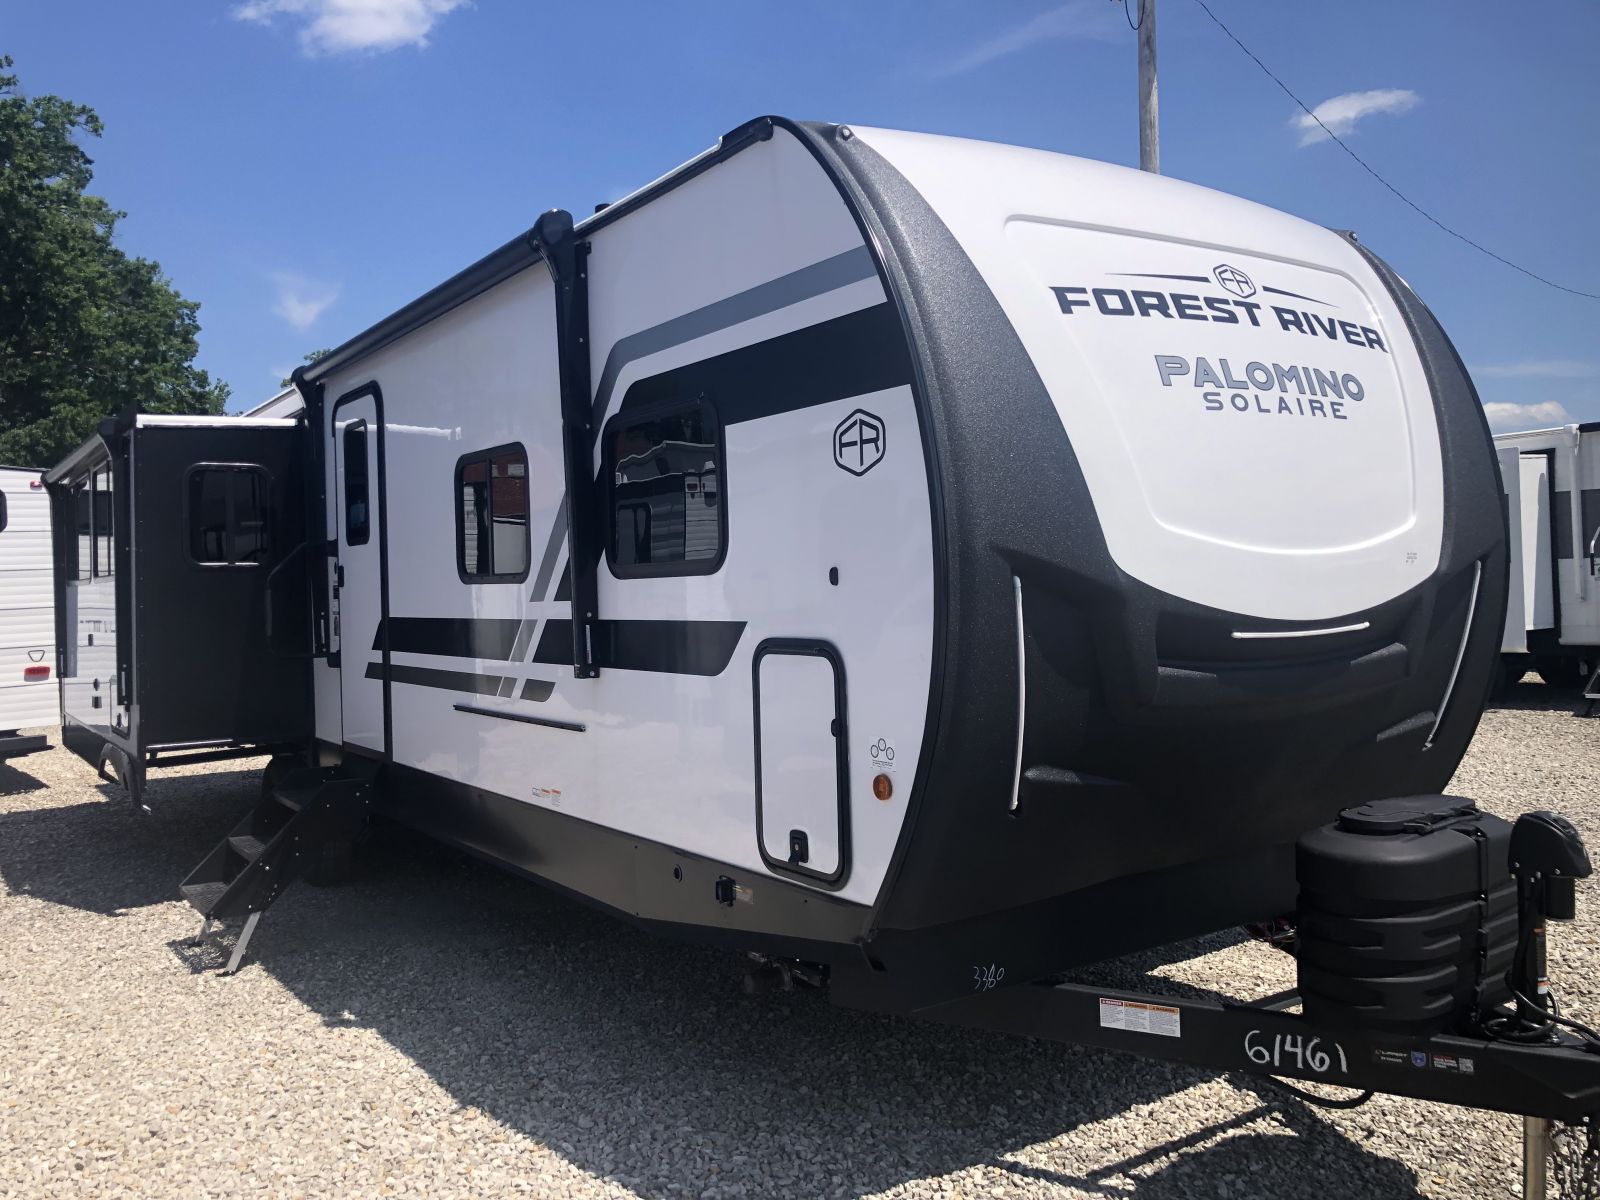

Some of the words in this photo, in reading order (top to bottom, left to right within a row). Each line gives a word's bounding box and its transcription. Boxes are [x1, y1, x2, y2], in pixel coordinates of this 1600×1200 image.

[1217, 266, 1252, 296] FR
[1048, 286, 1262, 327] FOREST
[1270, 305, 1390, 353] RIVER
[1154, 354, 1365, 402] PALOMINO
[1203, 391, 1348, 420] SOLAIRE
[837, 417, 881, 468] FR
[1244, 1029, 1348, 1074] 61461
